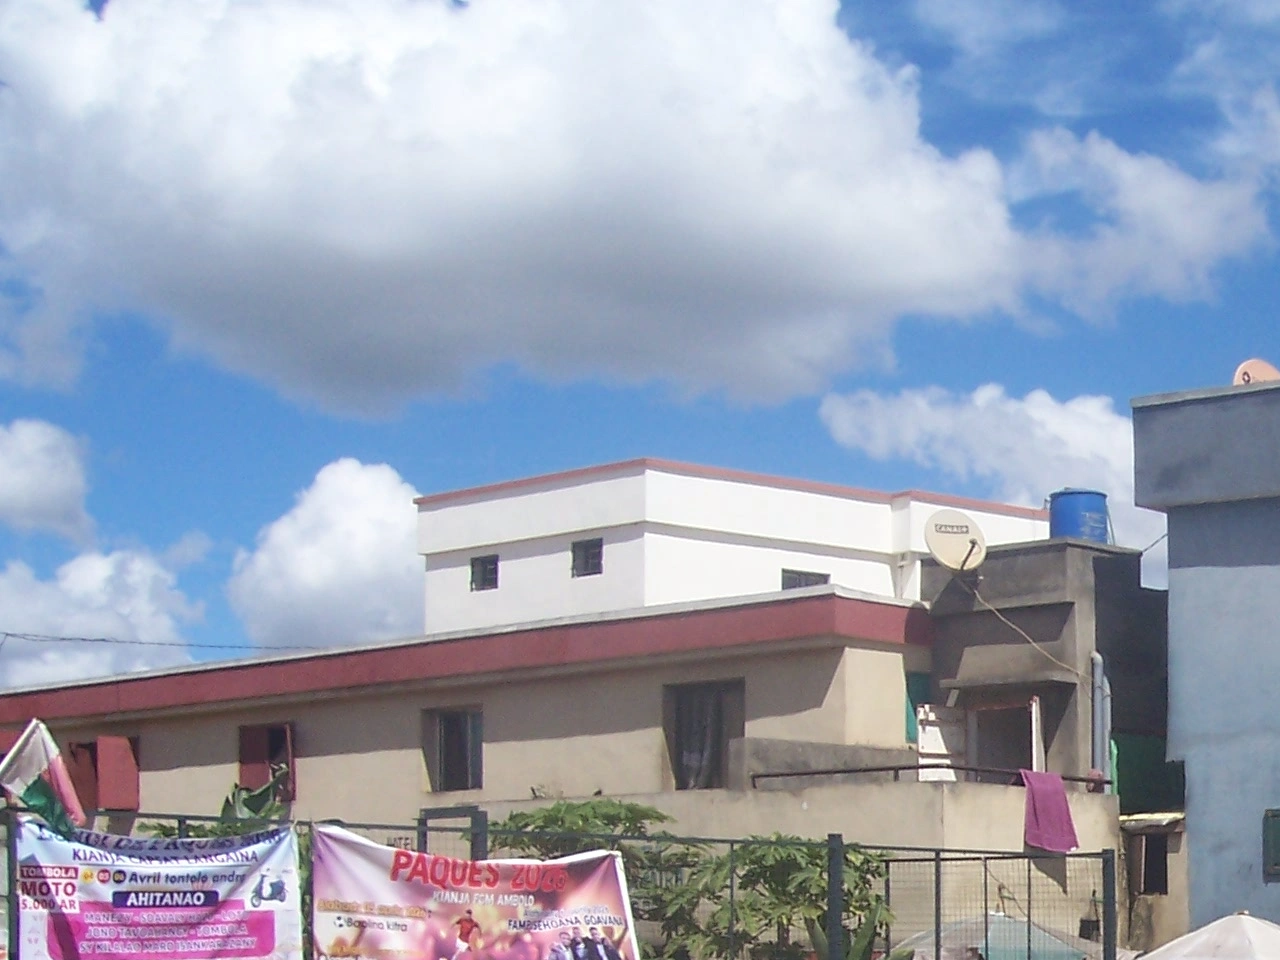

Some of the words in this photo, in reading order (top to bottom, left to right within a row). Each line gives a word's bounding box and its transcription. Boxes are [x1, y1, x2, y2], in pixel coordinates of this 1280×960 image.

[22, 868, 76, 877] TOMBOLA
[390, 849, 500, 889] PAQUES
[128, 871, 160, 884] Avril
[165, 871, 208, 884] tontolo
[22, 881, 76, 897] MOTO
[22, 899, 55, 910] 5.000
[60, 899, 76, 910] AR
[127, 892, 205, 906] AHITANAO
[585, 915, 624, 926] GOAVANA
